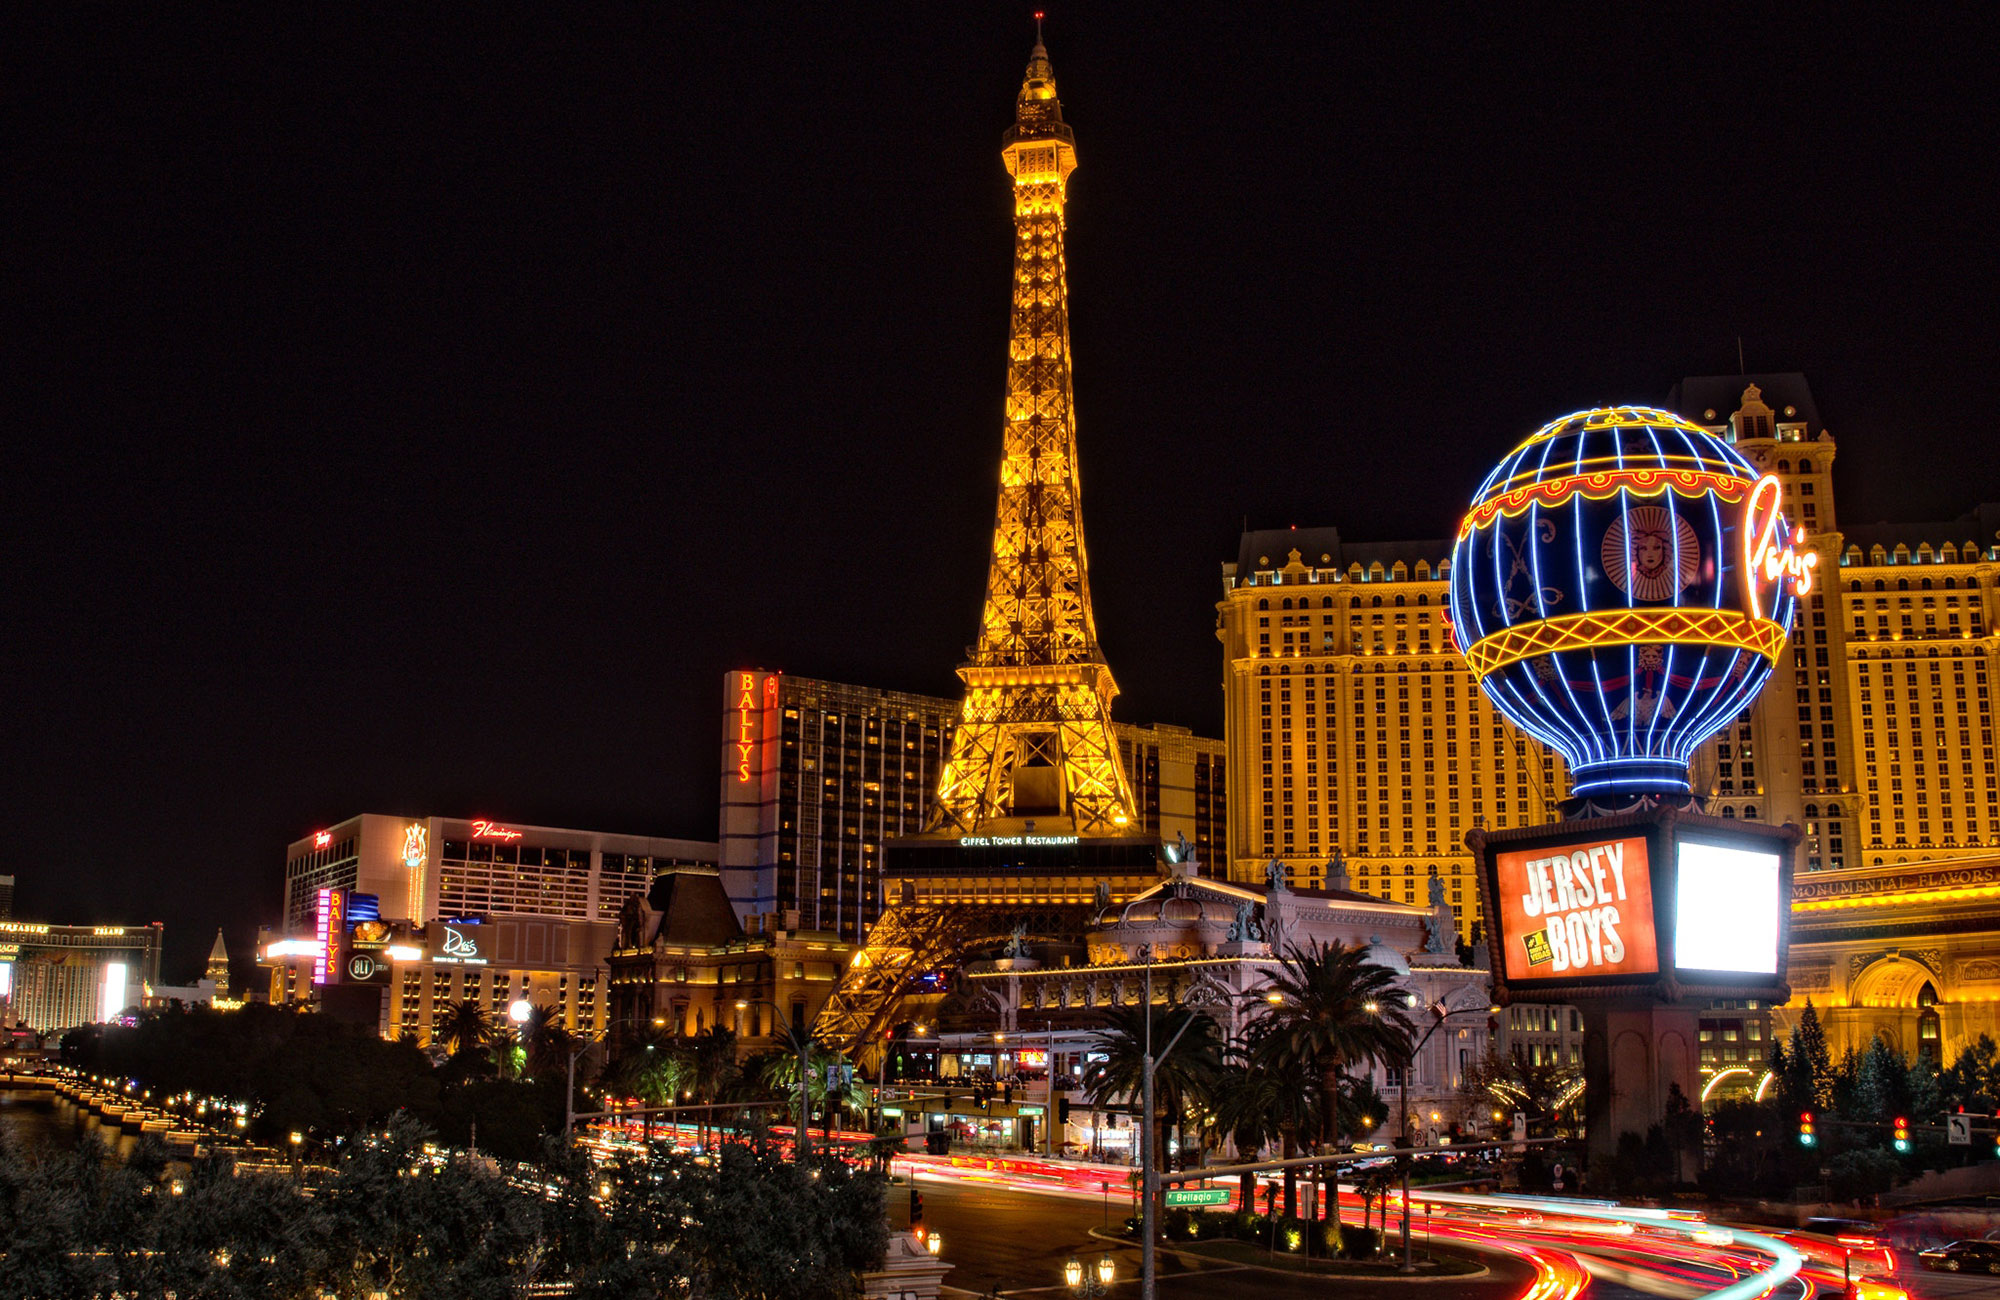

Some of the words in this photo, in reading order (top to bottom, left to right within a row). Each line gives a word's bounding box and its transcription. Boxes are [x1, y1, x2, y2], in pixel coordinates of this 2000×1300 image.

[1744, 474, 1817, 620] Paris
[738, 673, 755, 782] BALLYS
[471, 820, 522, 841] Flamingo
[960, 837, 990, 846] EIFFEL
[992, 836, 1022, 846] TOWER
[1025, 836, 1079, 845] RESTAURANT
[1522, 842, 1627, 917] JERSEY
[1792, 876, 1909, 898] MONUMENTAL
[1917, 868, 1994, 888] FLAVORS
[0, 924, 49, 934] TREASURE
[94, 927, 125, 936] ISLAND
[327, 893, 341, 973] BALLYS
[1546, 905, 1625, 972] BOYS
[354, 960, 370, 975] BLT
[1176, 1193, 1212, 1203] Bellagio
